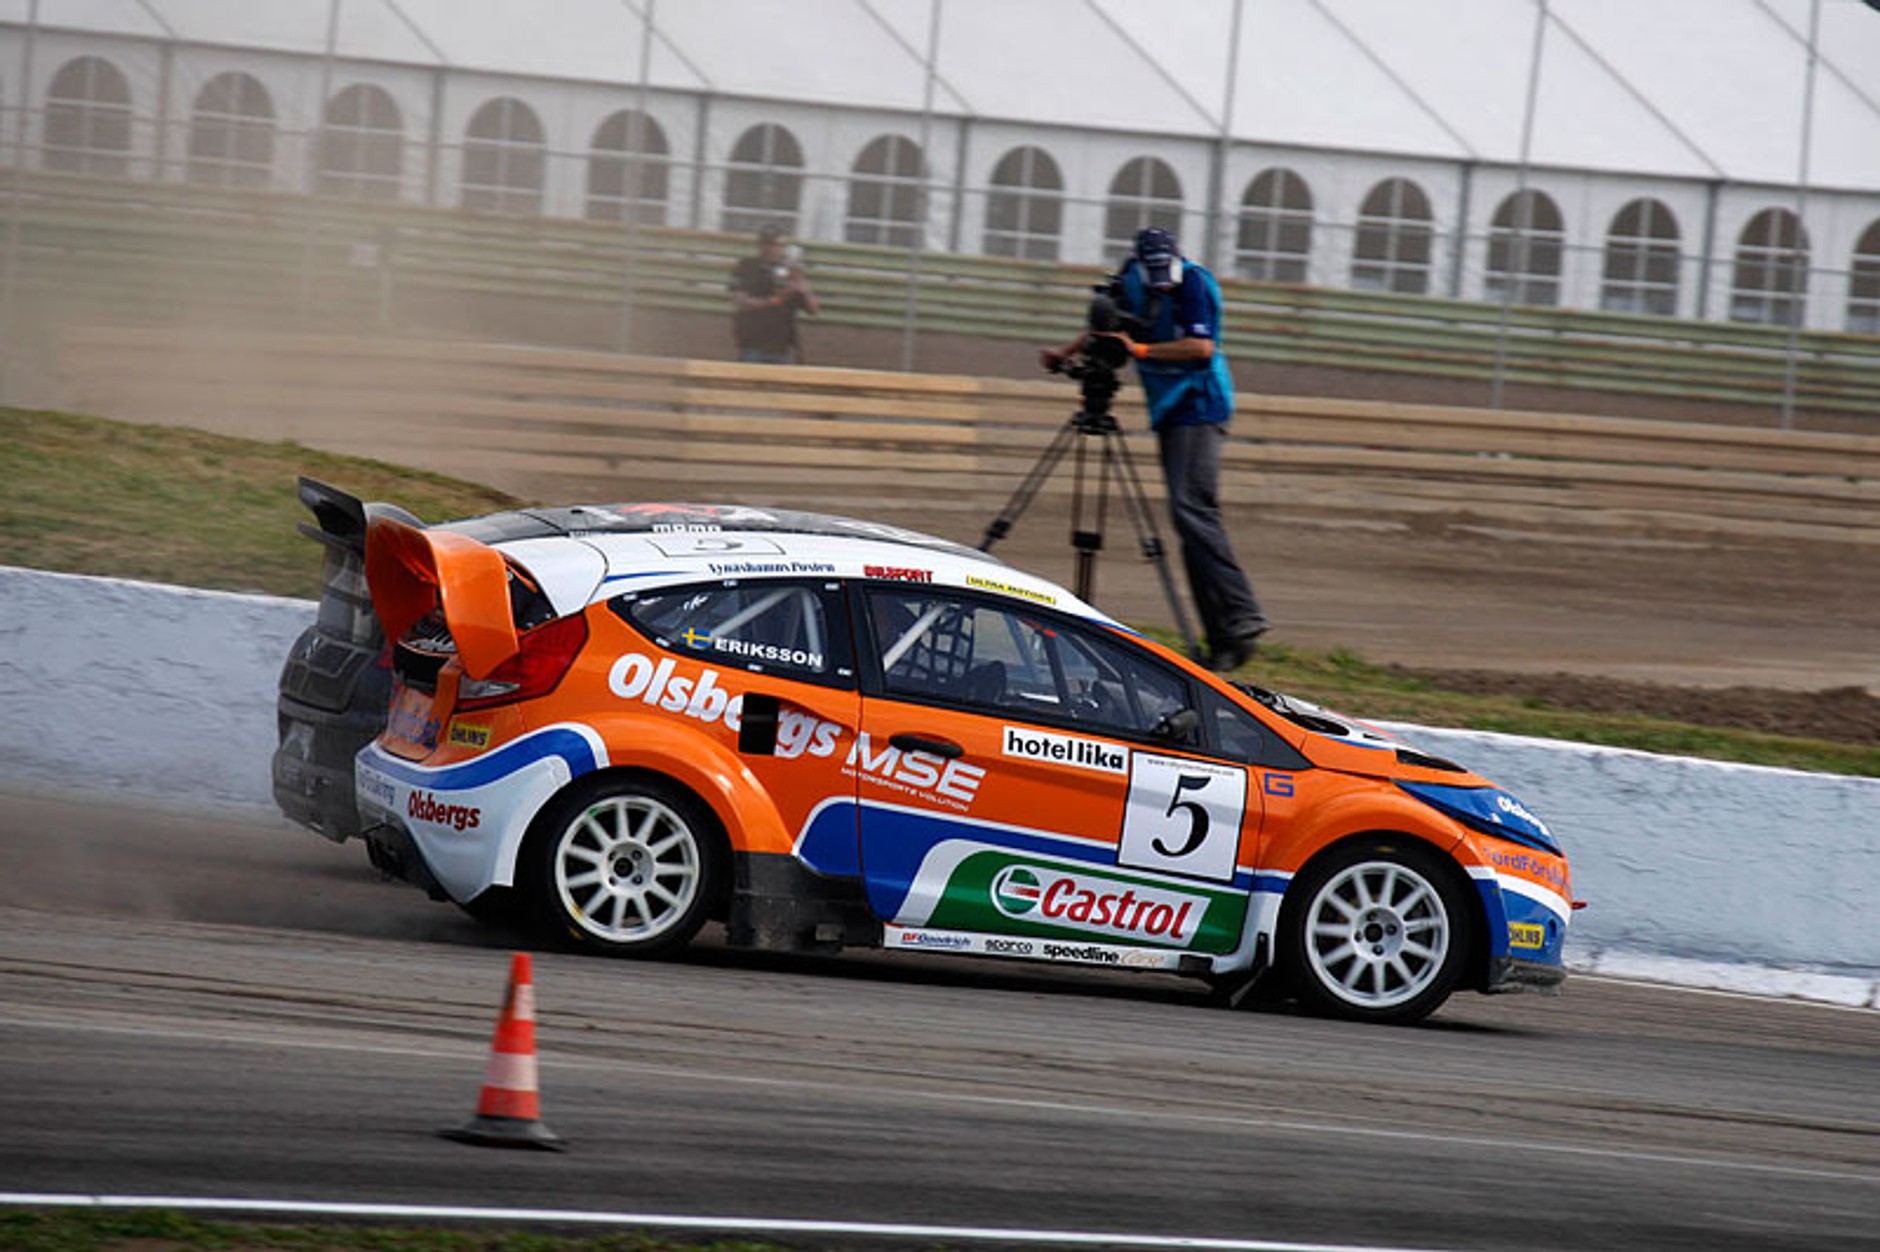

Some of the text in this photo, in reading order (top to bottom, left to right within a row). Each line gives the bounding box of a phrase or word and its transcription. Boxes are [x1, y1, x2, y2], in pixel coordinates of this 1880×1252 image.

[714, 637, 823, 667] ERIKSSON
[846, 730, 986, 802] MSE
[408, 790, 481, 831] Olsbergs
[1151, 773, 1211, 857] 5
[1041, 879, 1192, 939] Castrol
[985, 939, 1033, 954] sparco
[1043, 944, 1119, 964] speedline
